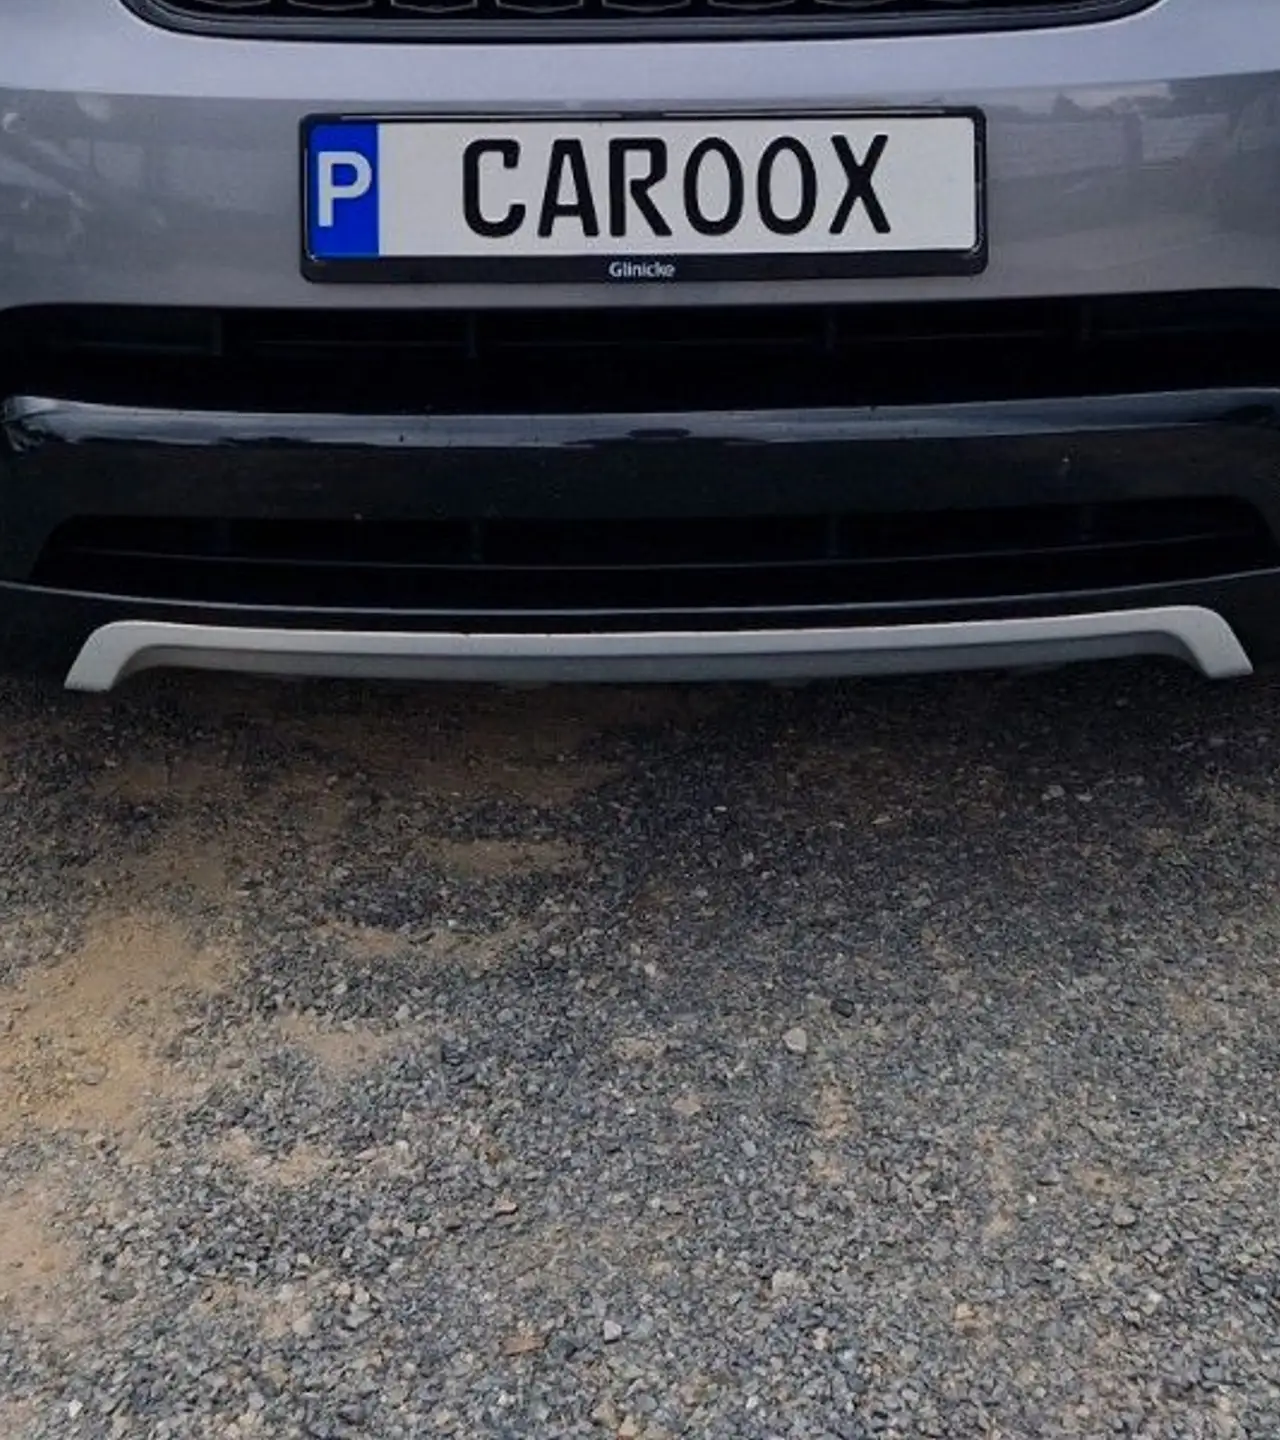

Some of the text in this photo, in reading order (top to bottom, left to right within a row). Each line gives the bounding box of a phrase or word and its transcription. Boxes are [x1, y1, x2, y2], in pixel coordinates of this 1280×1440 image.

[317, 133, 892, 238] P CAROOX
[607, 260, 677, 278] Glinicke
